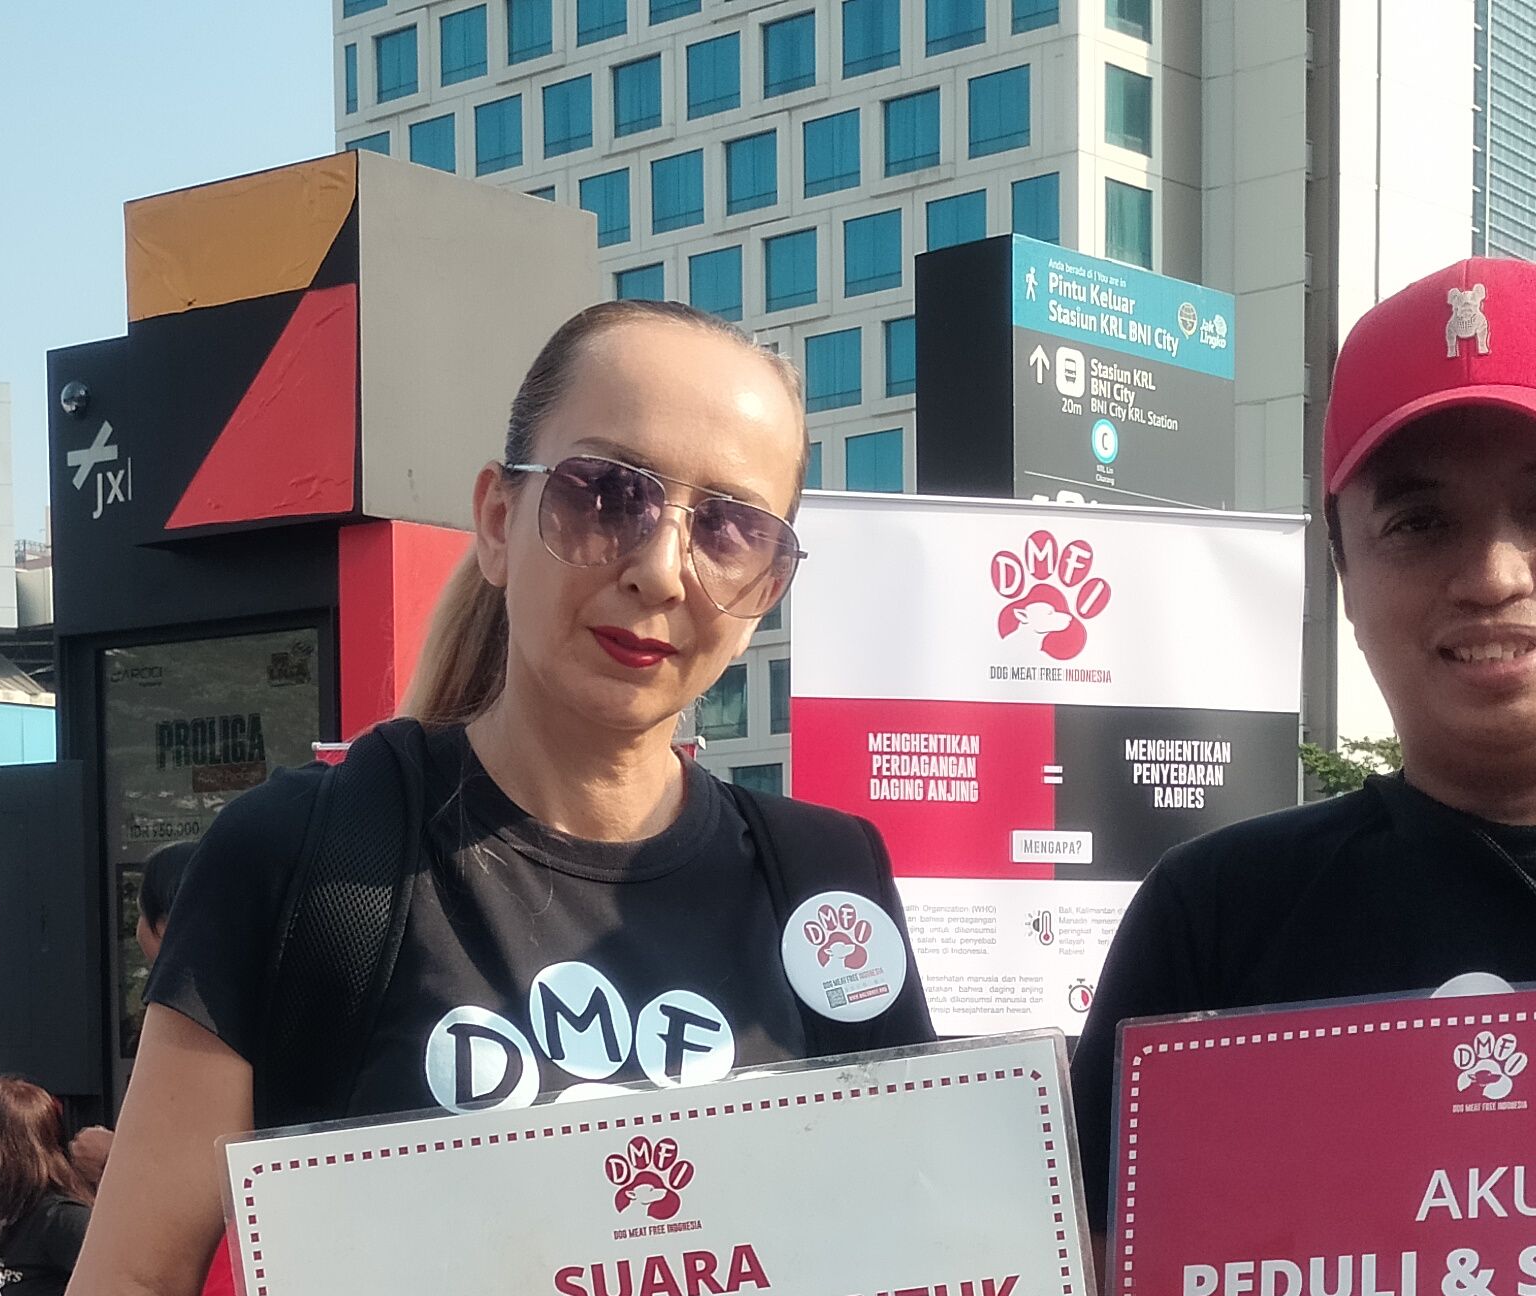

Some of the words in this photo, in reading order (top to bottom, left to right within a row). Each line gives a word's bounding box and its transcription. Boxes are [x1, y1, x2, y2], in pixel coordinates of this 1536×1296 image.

[1049, 259, 1064, 272] Anda
[1065, 263, 1085, 278] berada
[1097, 273, 1108, 284] You
[1109, 277, 1119, 286] are
[1049, 272, 1086, 301] Pintu
[1090, 284, 1136, 315] Keluar
[1049, 300, 1097, 332] Stasiun
[1100, 314, 1126, 340] KRL
[1129, 323, 1152, 346] BNI
[1154, 327, 1180, 358] City
[1090, 359, 1131, 385] Stasiun
[1133, 369, 1156, 391] KRL
[1090, 378, 1110, 399] BNI
[1113, 383, 1136, 406] City
[1062, 398, 1082, 416] 20m
[1090, 398, 1107, 415] BNI
[1109, 402, 1127, 422] City
[1128, 405, 1146, 424] KRL
[1148, 411, 1178, 431] Station
[1102, 432, 1108, 450] C
[994, 532, 1107, 616] DMFI
[989, 666, 1009, 680] DOG
[1011, 666, 1037, 682] MEAT
[1039, 667, 1062, 682] FREE
[1064, 668, 1112, 684] INDONESIA
[156, 713, 266, 770] PROLIGA
[868, 732, 980, 756] MENGHENTIKAN
[1125, 738, 1231, 764] MENGHENTIKAN
[872, 754, 976, 778] PERDAGANGAN
[1132, 764, 1224, 787] PENYEBARAN
[870, 778, 924, 801] DAGING
[928, 780, 979, 803] ANJING
[1154, 786, 1204, 810] RABIES
[804, 905, 868, 944] DMFI
[1456, 1035, 1524, 1074] DMFI
[607, 1139, 690, 1189] DMFI
[628, 1226, 648, 1238] MEAT
[649, 1224, 666, 1236] FREE
